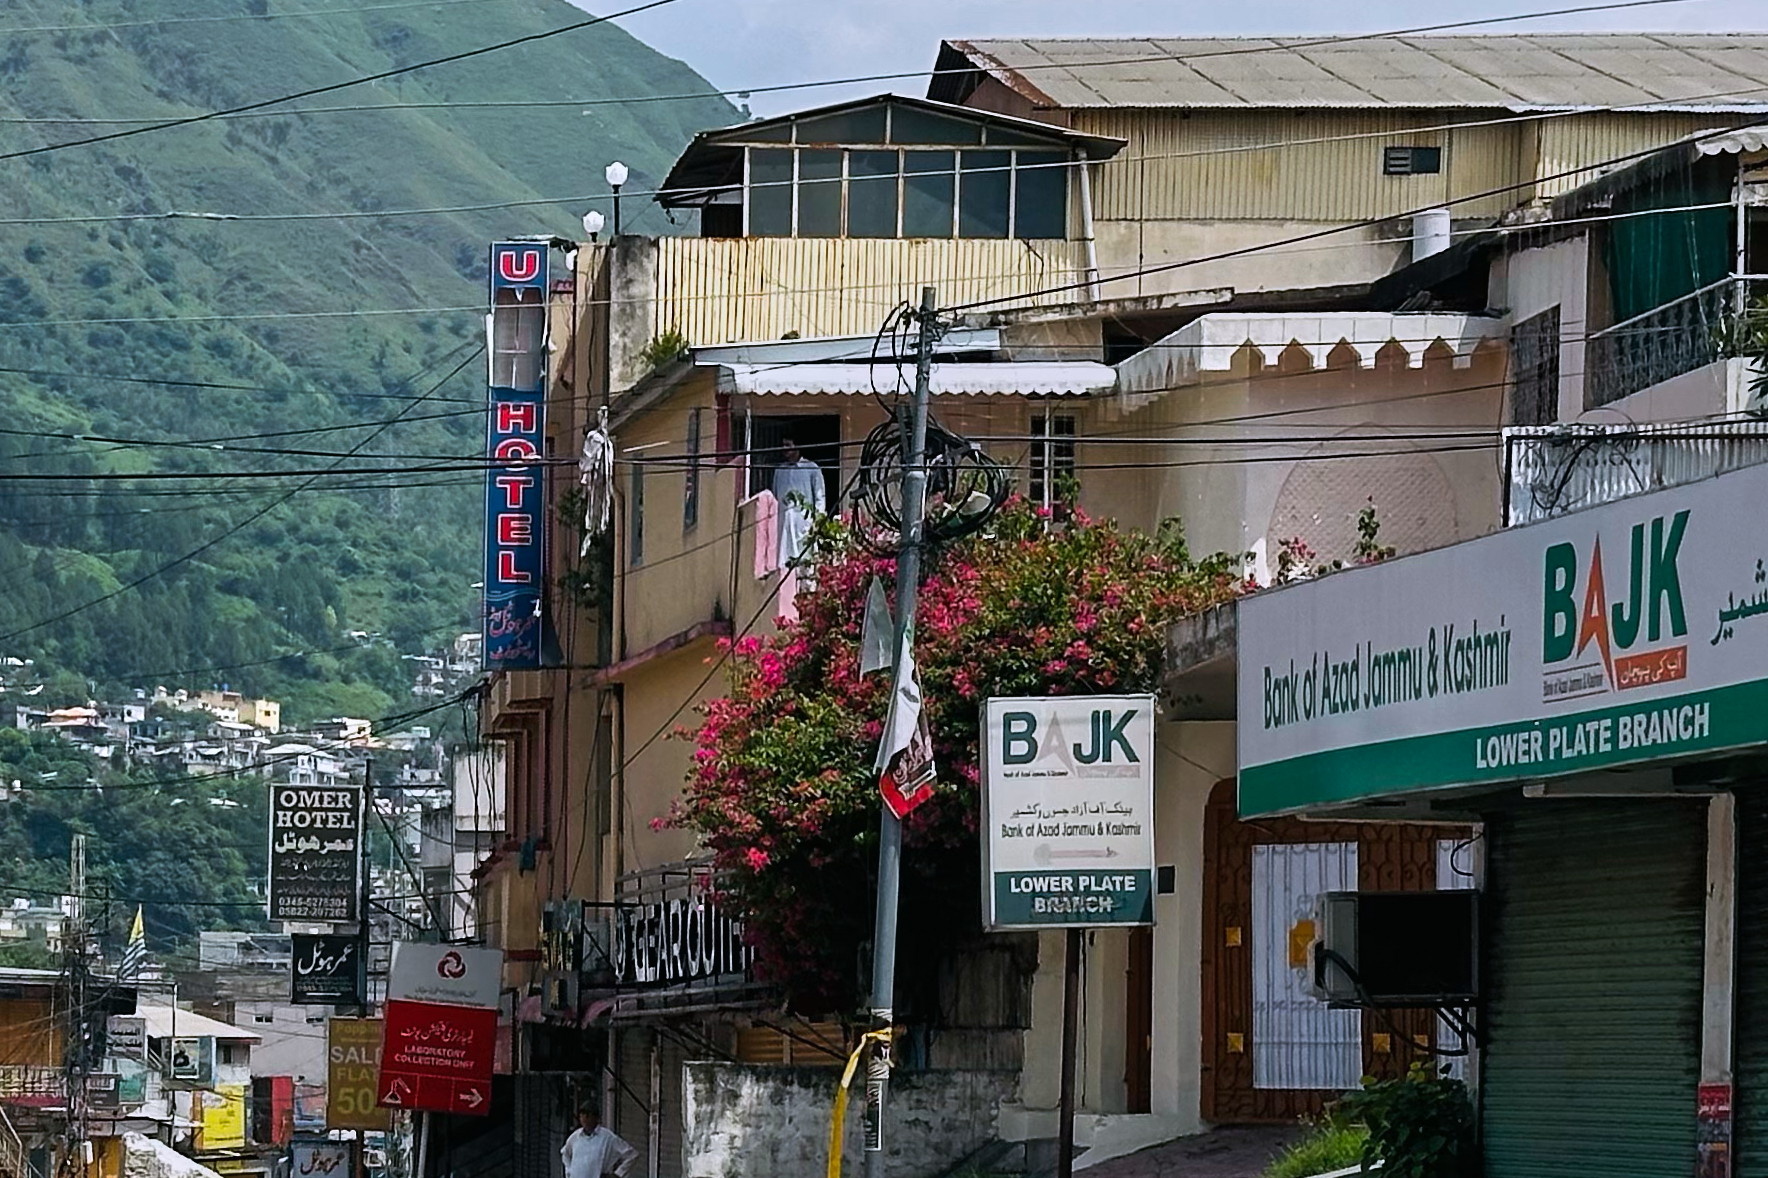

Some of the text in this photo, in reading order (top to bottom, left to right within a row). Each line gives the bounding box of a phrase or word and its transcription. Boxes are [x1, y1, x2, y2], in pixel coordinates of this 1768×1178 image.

[495, 402, 537, 584] HOTEL
[1543, 510, 1691, 691] BAJK
[1710, 558, 1768, 646] شمیر
[1264, 614, 1511, 729] Bank of Azad Jammu & Kashmir
[1002, 710, 1140, 775] BAJK
[1476, 702, 1710, 769] LOWER PLATE BRANCH
[276, 811, 355, 829] HOTEL
[280, 790, 353, 809] OMER
[1002, 823, 1024, 839] Bank
[1037, 823, 1060, 838] Azad
[1062, 822, 1095, 838] Jammu
[1097, 822, 1104, 836] &
[1106, 821, 1141, 836] Kashmir
[1010, 876, 1136, 893] LOWER PLATE
[1034, 897, 1113, 914] BRANCH
[634, 900, 683, 983] GEAR
[394, 1053, 475, 1069] COLLECTION UNIT
[404, 1045, 466, 1058] LABORATORY
